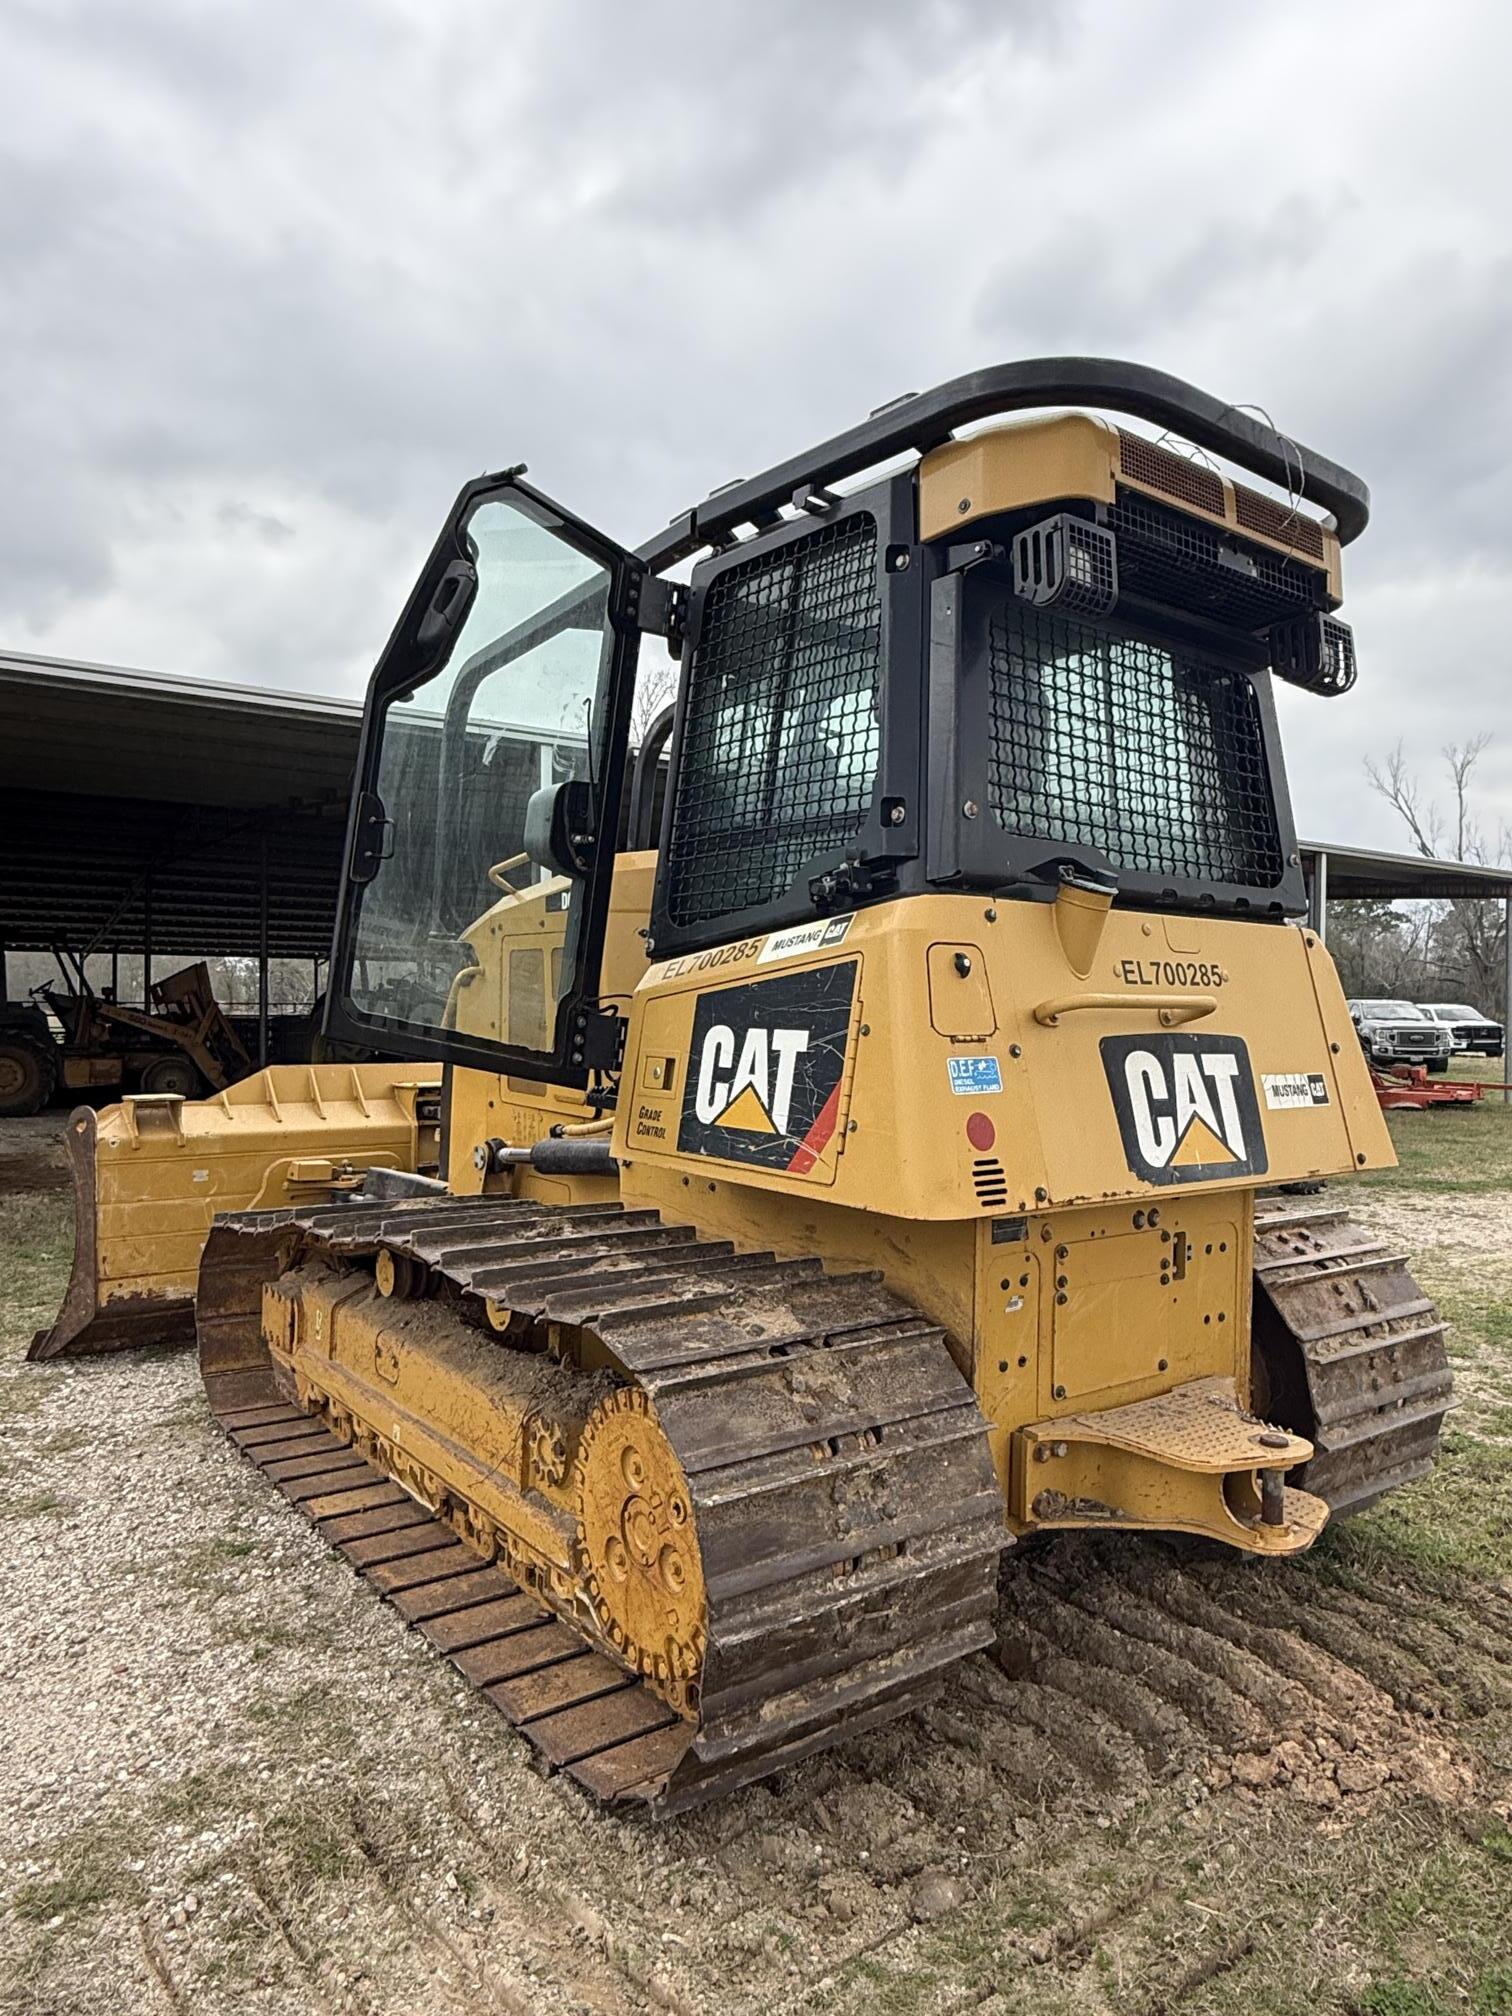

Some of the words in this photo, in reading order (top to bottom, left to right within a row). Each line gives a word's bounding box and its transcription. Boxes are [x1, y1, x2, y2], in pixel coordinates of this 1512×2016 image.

[771, 928, 822, 951] MUSTANG
[824, 922, 849, 939] CAT
[662, 938, 763, 981] EL700285
[1120, 960, 1223, 987] EL700285
[695, 1024, 810, 1136] CAT
[1271, 1083, 1309, 1097] MUSTANG
[1310, 1081, 1325, 1097] CAT
[1124, 1050, 1247, 1169] CAT
